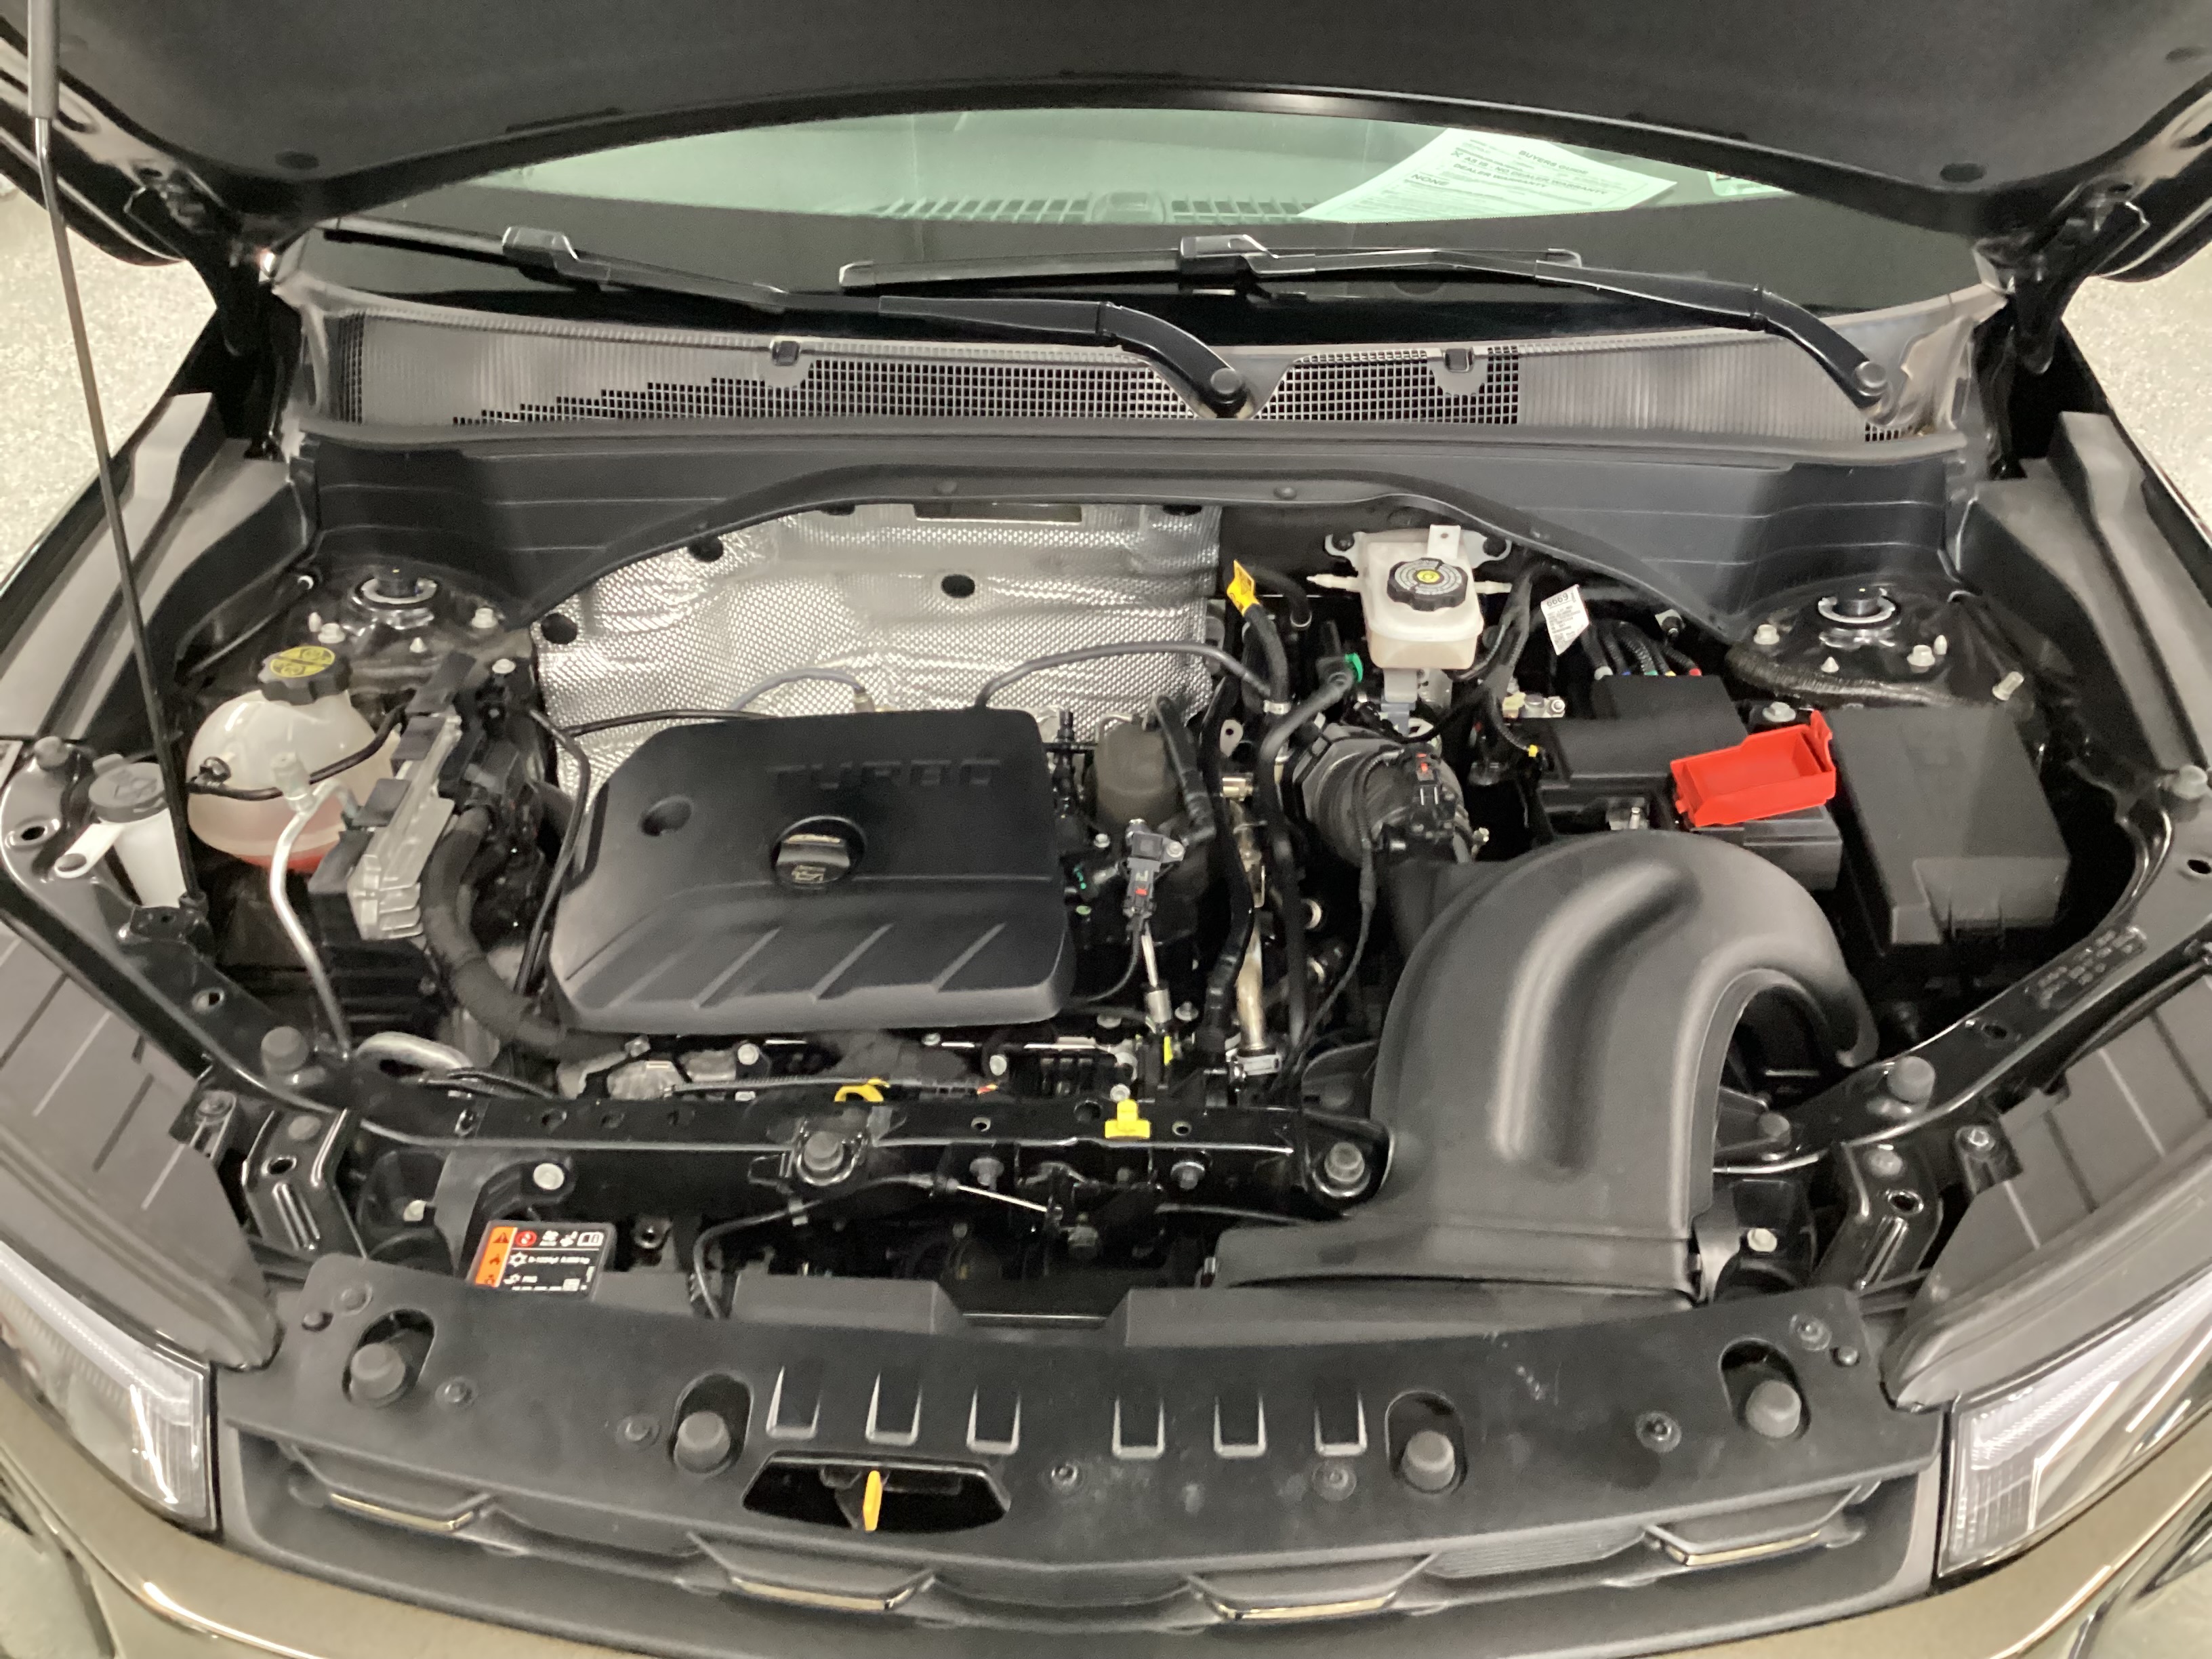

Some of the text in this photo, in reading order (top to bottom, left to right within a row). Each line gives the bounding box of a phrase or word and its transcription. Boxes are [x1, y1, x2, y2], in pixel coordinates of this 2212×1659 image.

[1519, 150, 1557, 167] BUYERS
[1453, 163, 1492, 177] DEALER
[1411, 173, 1450, 186] NONE
